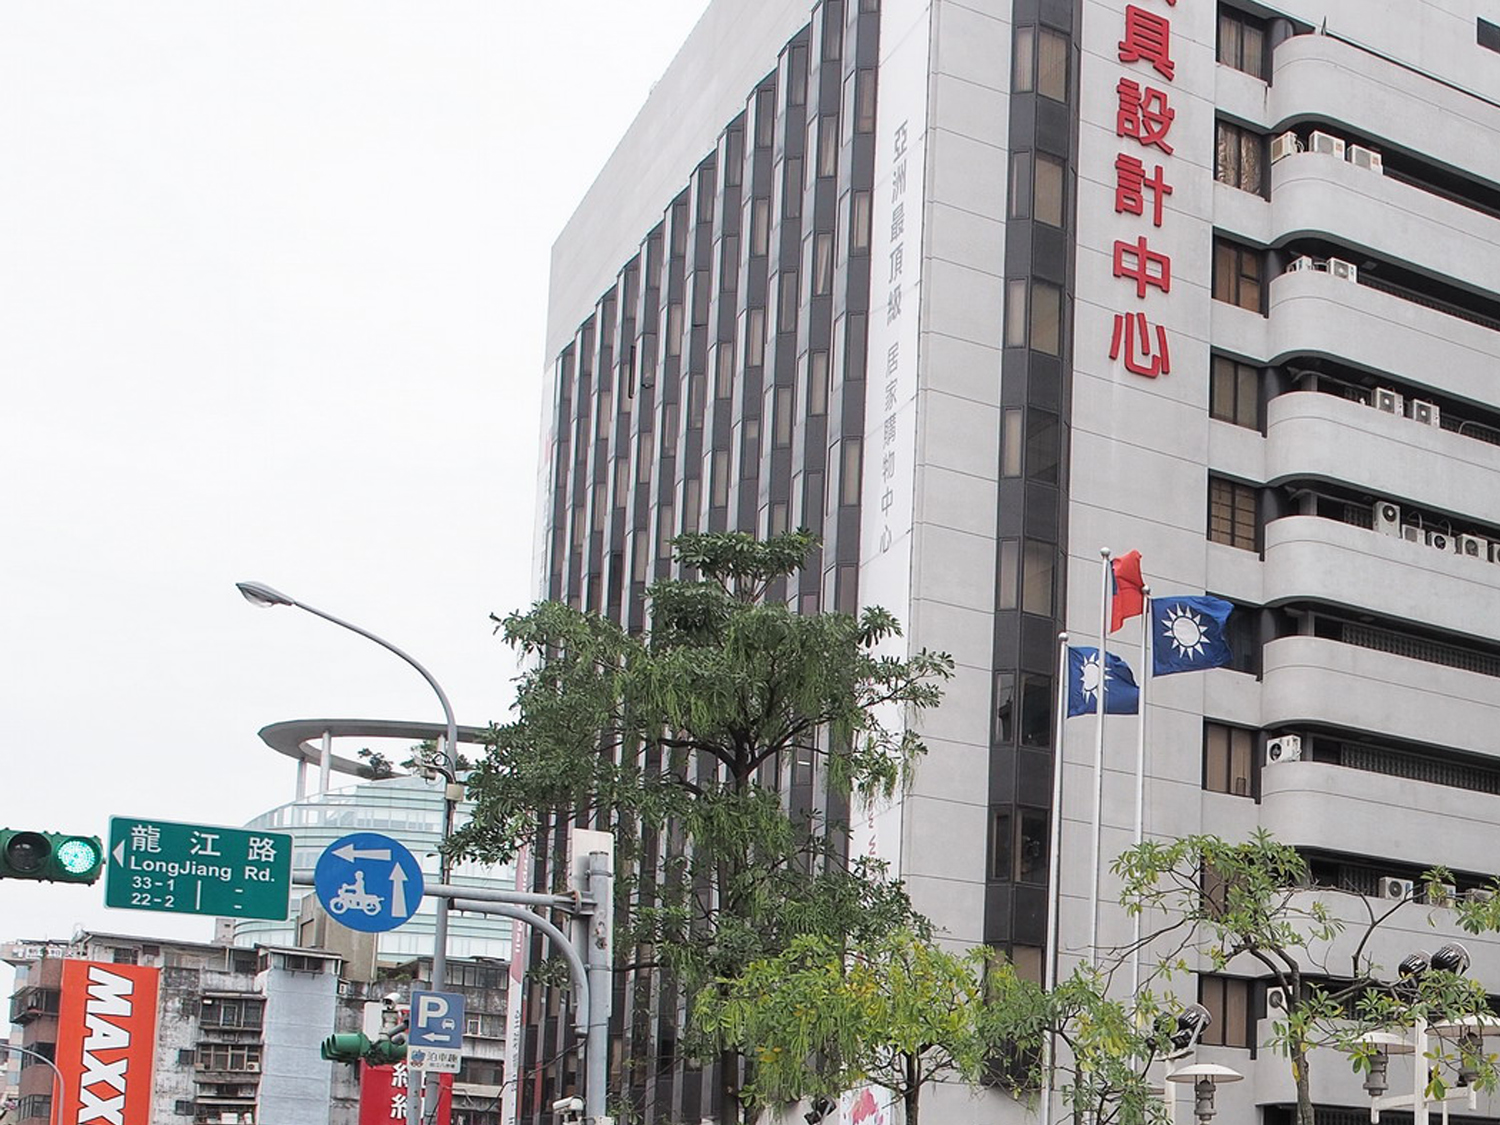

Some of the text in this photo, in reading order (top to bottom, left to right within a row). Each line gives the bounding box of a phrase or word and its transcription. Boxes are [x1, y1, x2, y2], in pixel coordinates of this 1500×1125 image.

[1109, 0, 1176, 379] 具設計中心
[130, 824, 277, 863] 龍江路
[130, 855, 275, 882] LongJiang Rd.
[132, 875, 175, 892] 33-1
[131, 892, 175, 908] 22-2
[418, 995, 449, 1028] P
